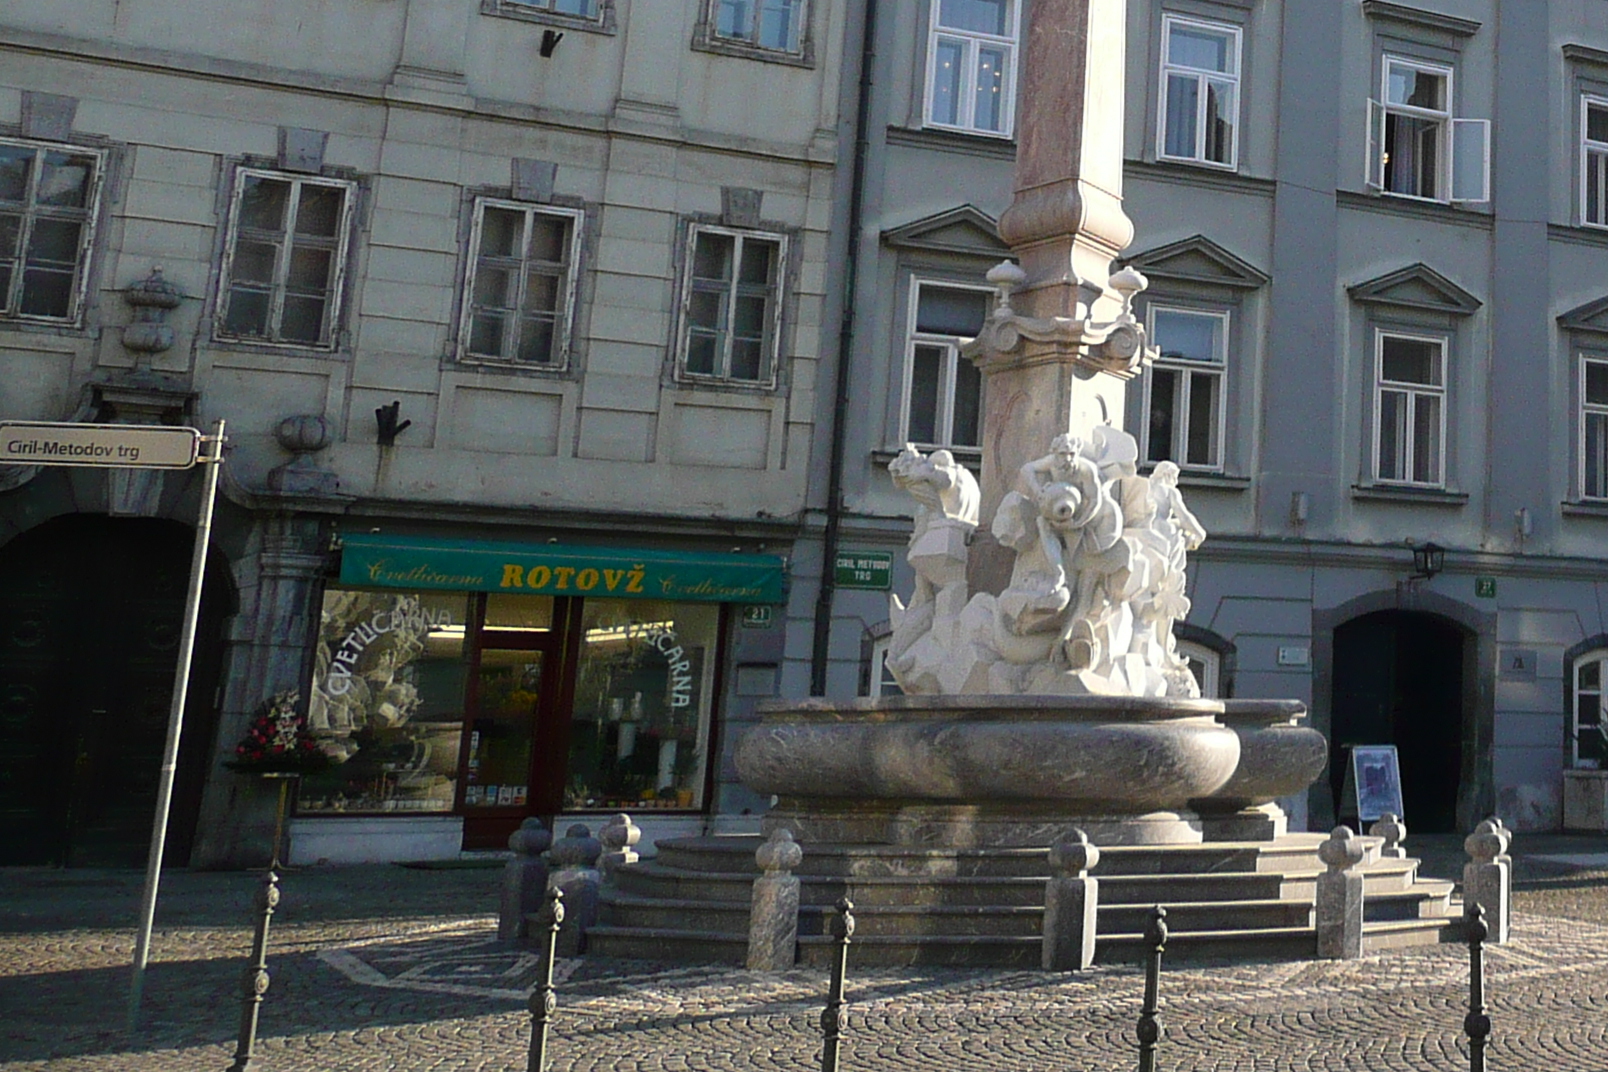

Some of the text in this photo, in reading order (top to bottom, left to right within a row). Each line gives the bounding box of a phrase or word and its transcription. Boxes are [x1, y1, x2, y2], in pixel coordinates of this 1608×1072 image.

[8, 440, 140, 460] Ciril-Metodov trg
[500, 563, 645, 593] ROTOVŽ
[854, 570, 871, 581] TRG
[752, 607, 764, 619] 21
[328, 607, 451, 695] CVETLIČARNA
